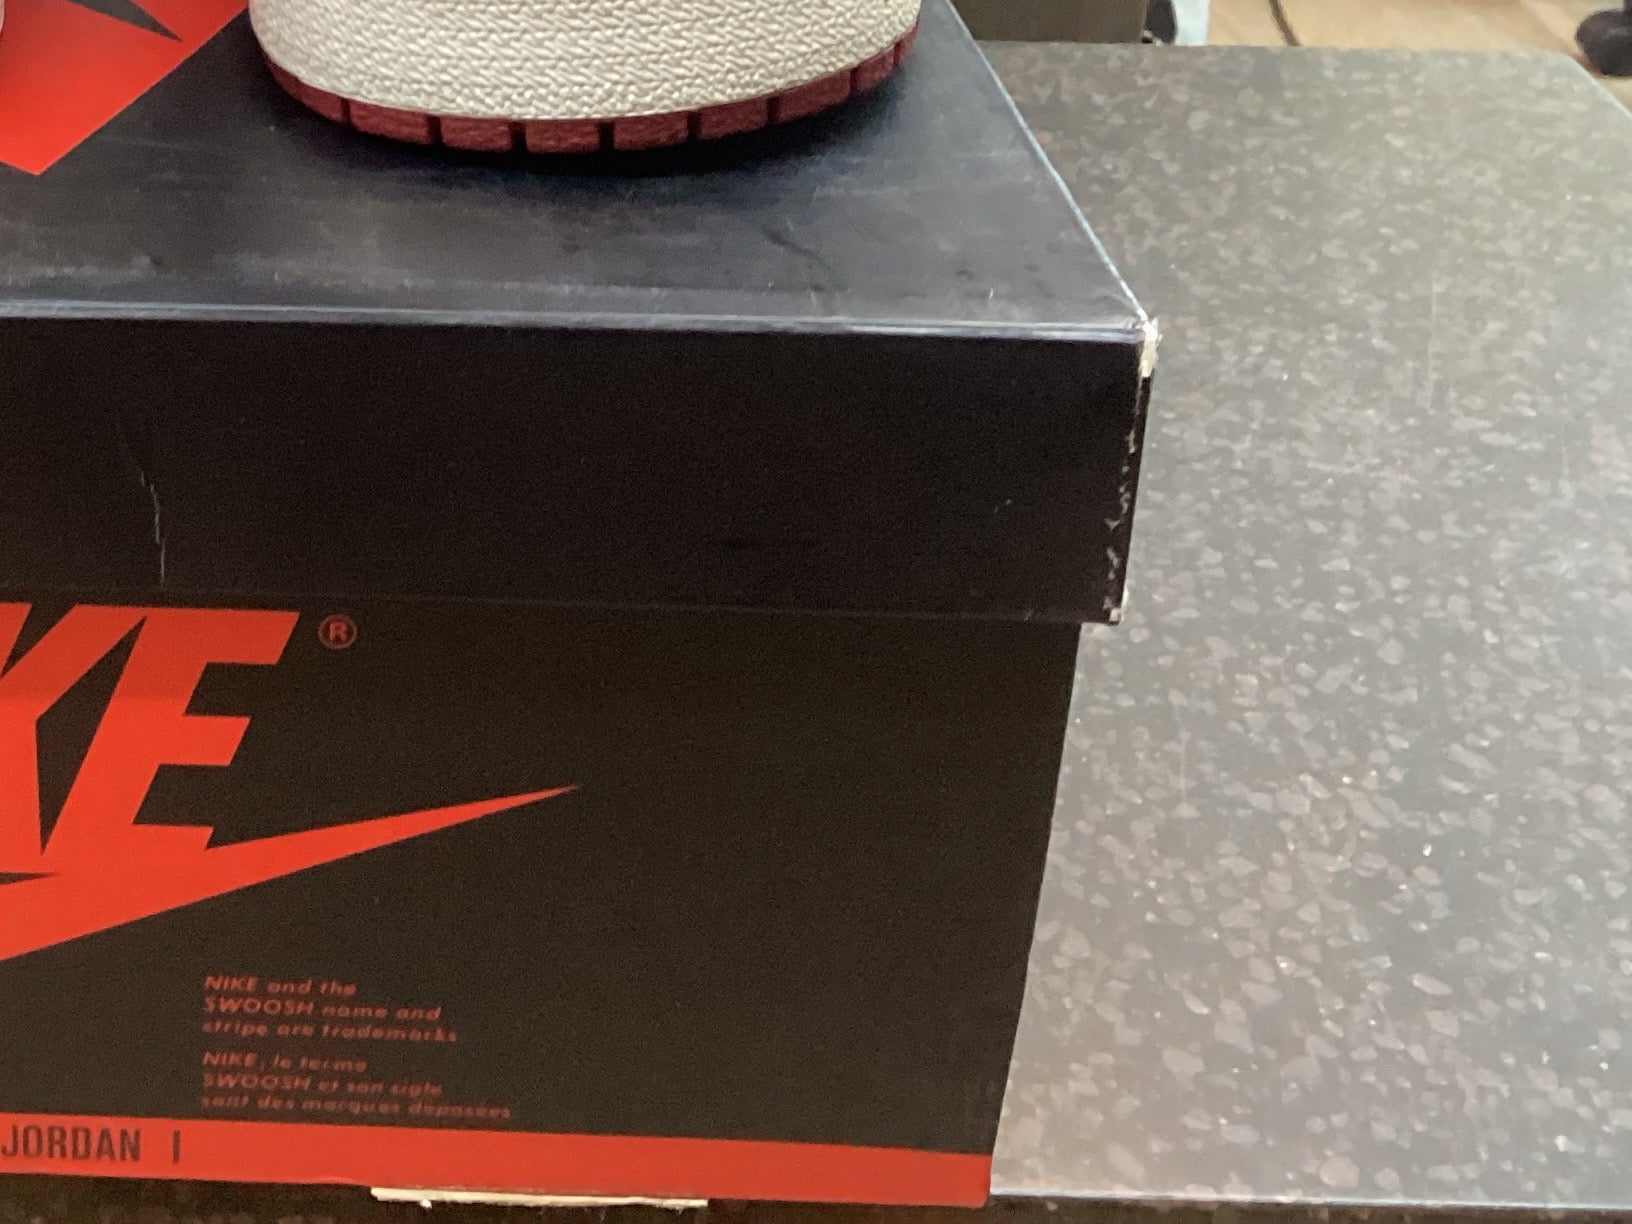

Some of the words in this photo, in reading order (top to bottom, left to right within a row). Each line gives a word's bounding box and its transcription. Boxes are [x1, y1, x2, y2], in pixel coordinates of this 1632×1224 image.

[204, 974, 258, 993] NIKE
[267, 977, 313, 994] and
[320, 979, 358, 996] the
[203, 996, 315, 1015] SWOOSH
[321, 1004, 389, 1019] name
[395, 1005, 442, 1021] and
[276, 1024, 315, 1037] are
[321, 1024, 458, 1042] trademarks
[202, 1073, 312, 1092] SWOOSH
[0, 1123, 142, 1163] JORDAN
